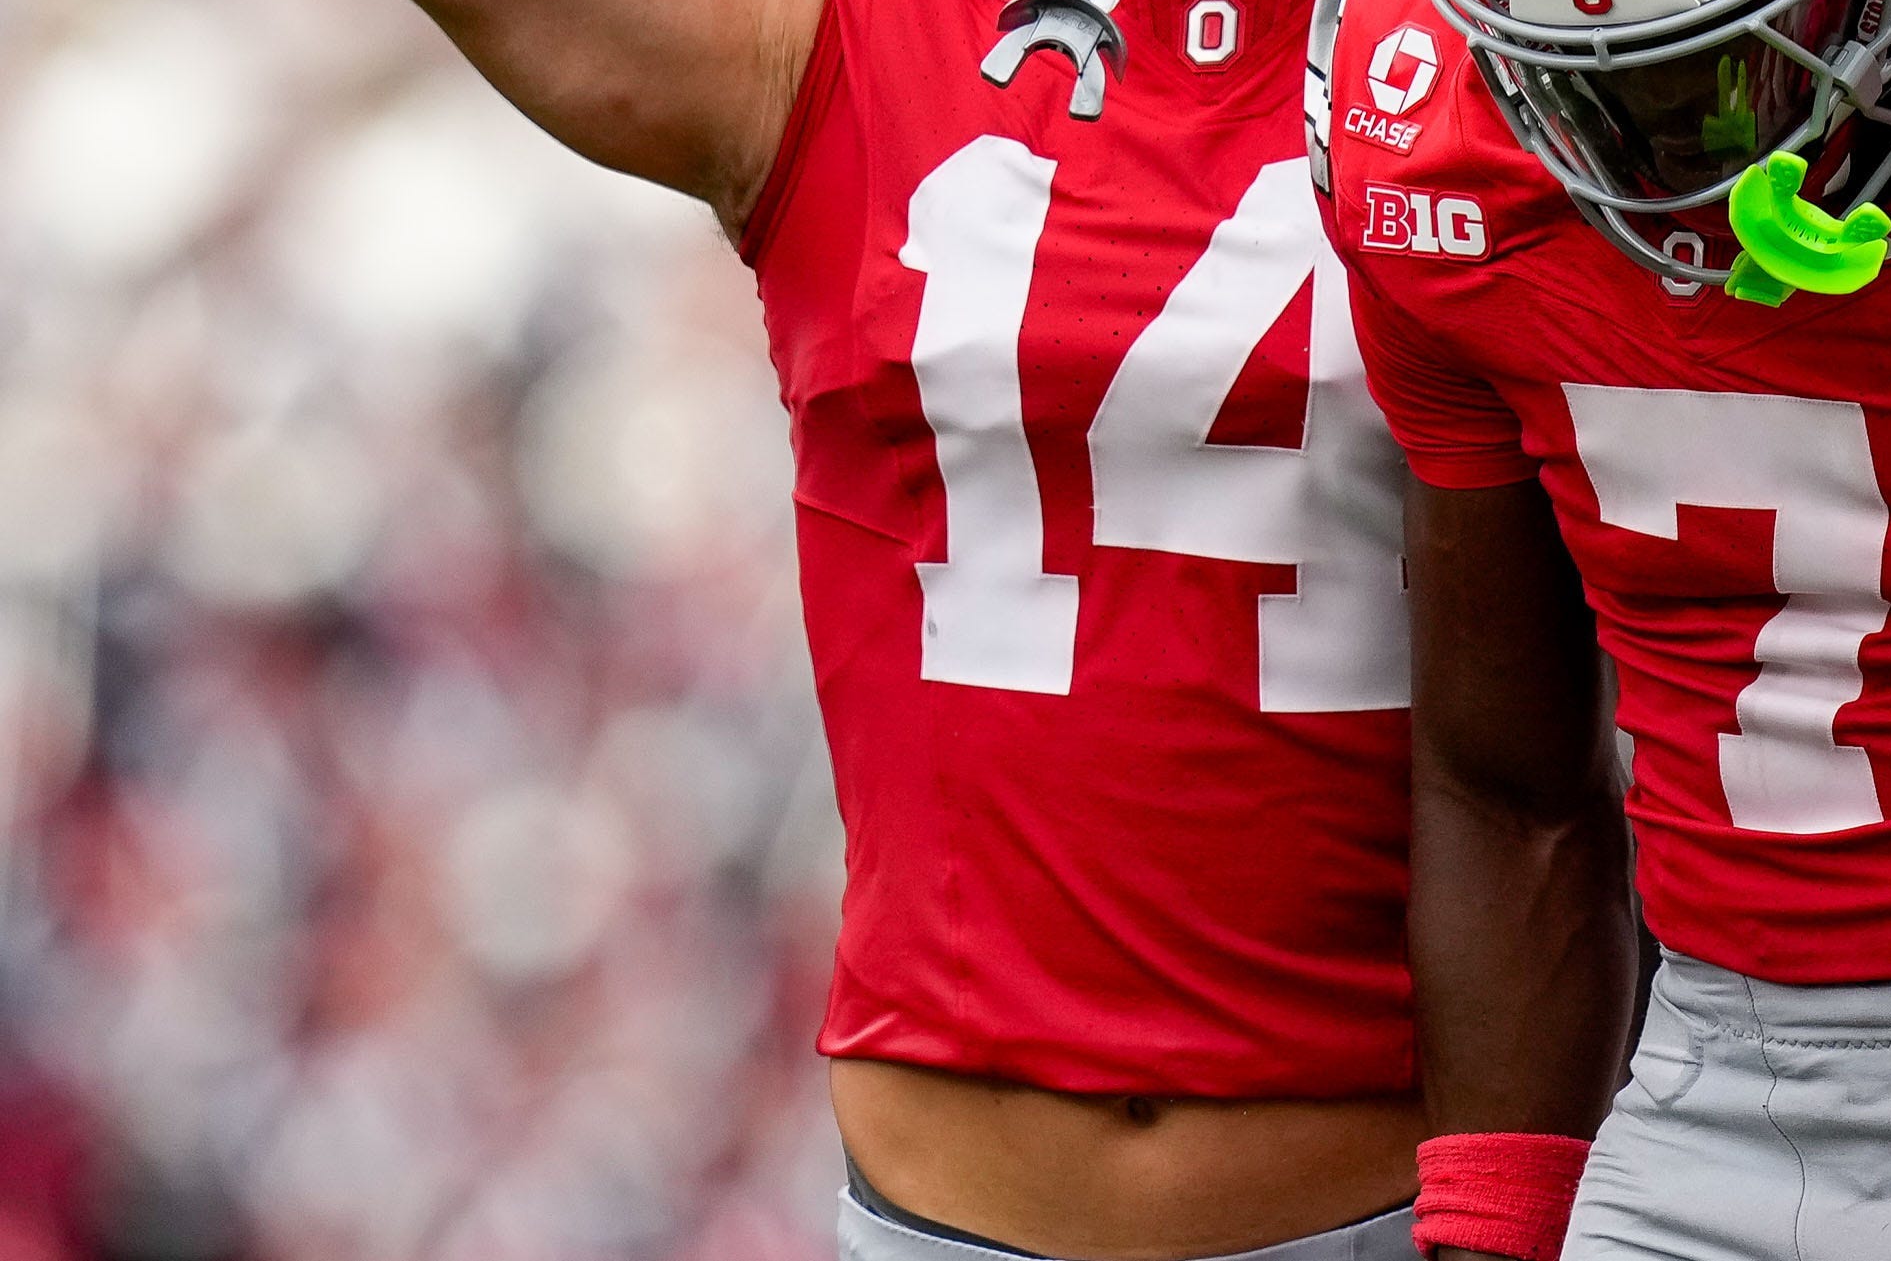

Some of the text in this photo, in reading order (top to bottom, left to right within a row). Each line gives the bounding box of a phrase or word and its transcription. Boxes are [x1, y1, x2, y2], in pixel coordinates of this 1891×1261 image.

[1344, 107, 1418, 150] CHASE
[899, 134, 1412, 713] 14
[1560, 382, 1891, 835] 7
